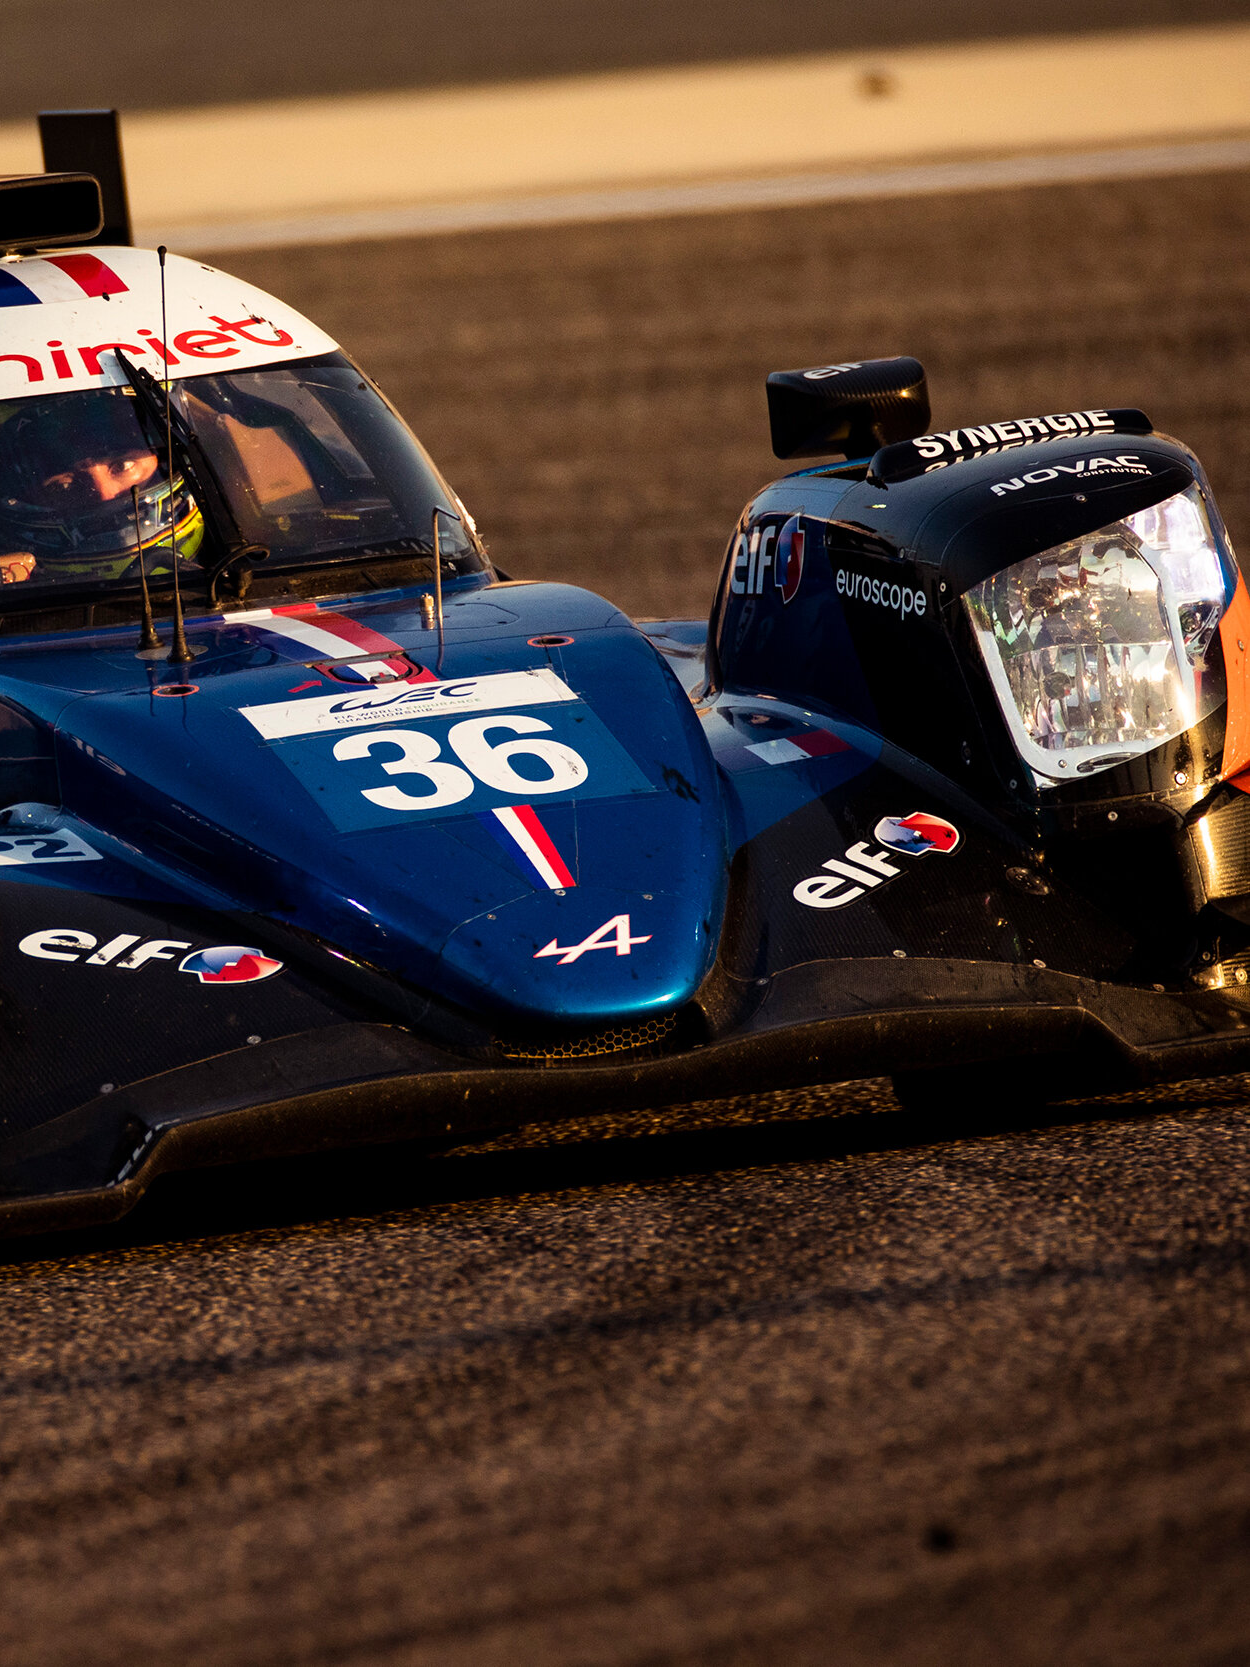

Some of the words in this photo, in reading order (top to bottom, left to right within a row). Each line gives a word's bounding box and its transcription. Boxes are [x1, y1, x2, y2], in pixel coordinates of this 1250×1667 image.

[912, 410, 1116, 458] SYNERGIE
[990, 455, 1148, 497] NOVAC
[1076, 467, 1153, 479] CONSTRUTORA
[731, 525, 776, 595] elf
[836, 569, 927, 620] euroscope
[332, 715, 589, 811] 36
[793, 841, 902, 909] elf
[18, 928, 192, 970] elf
